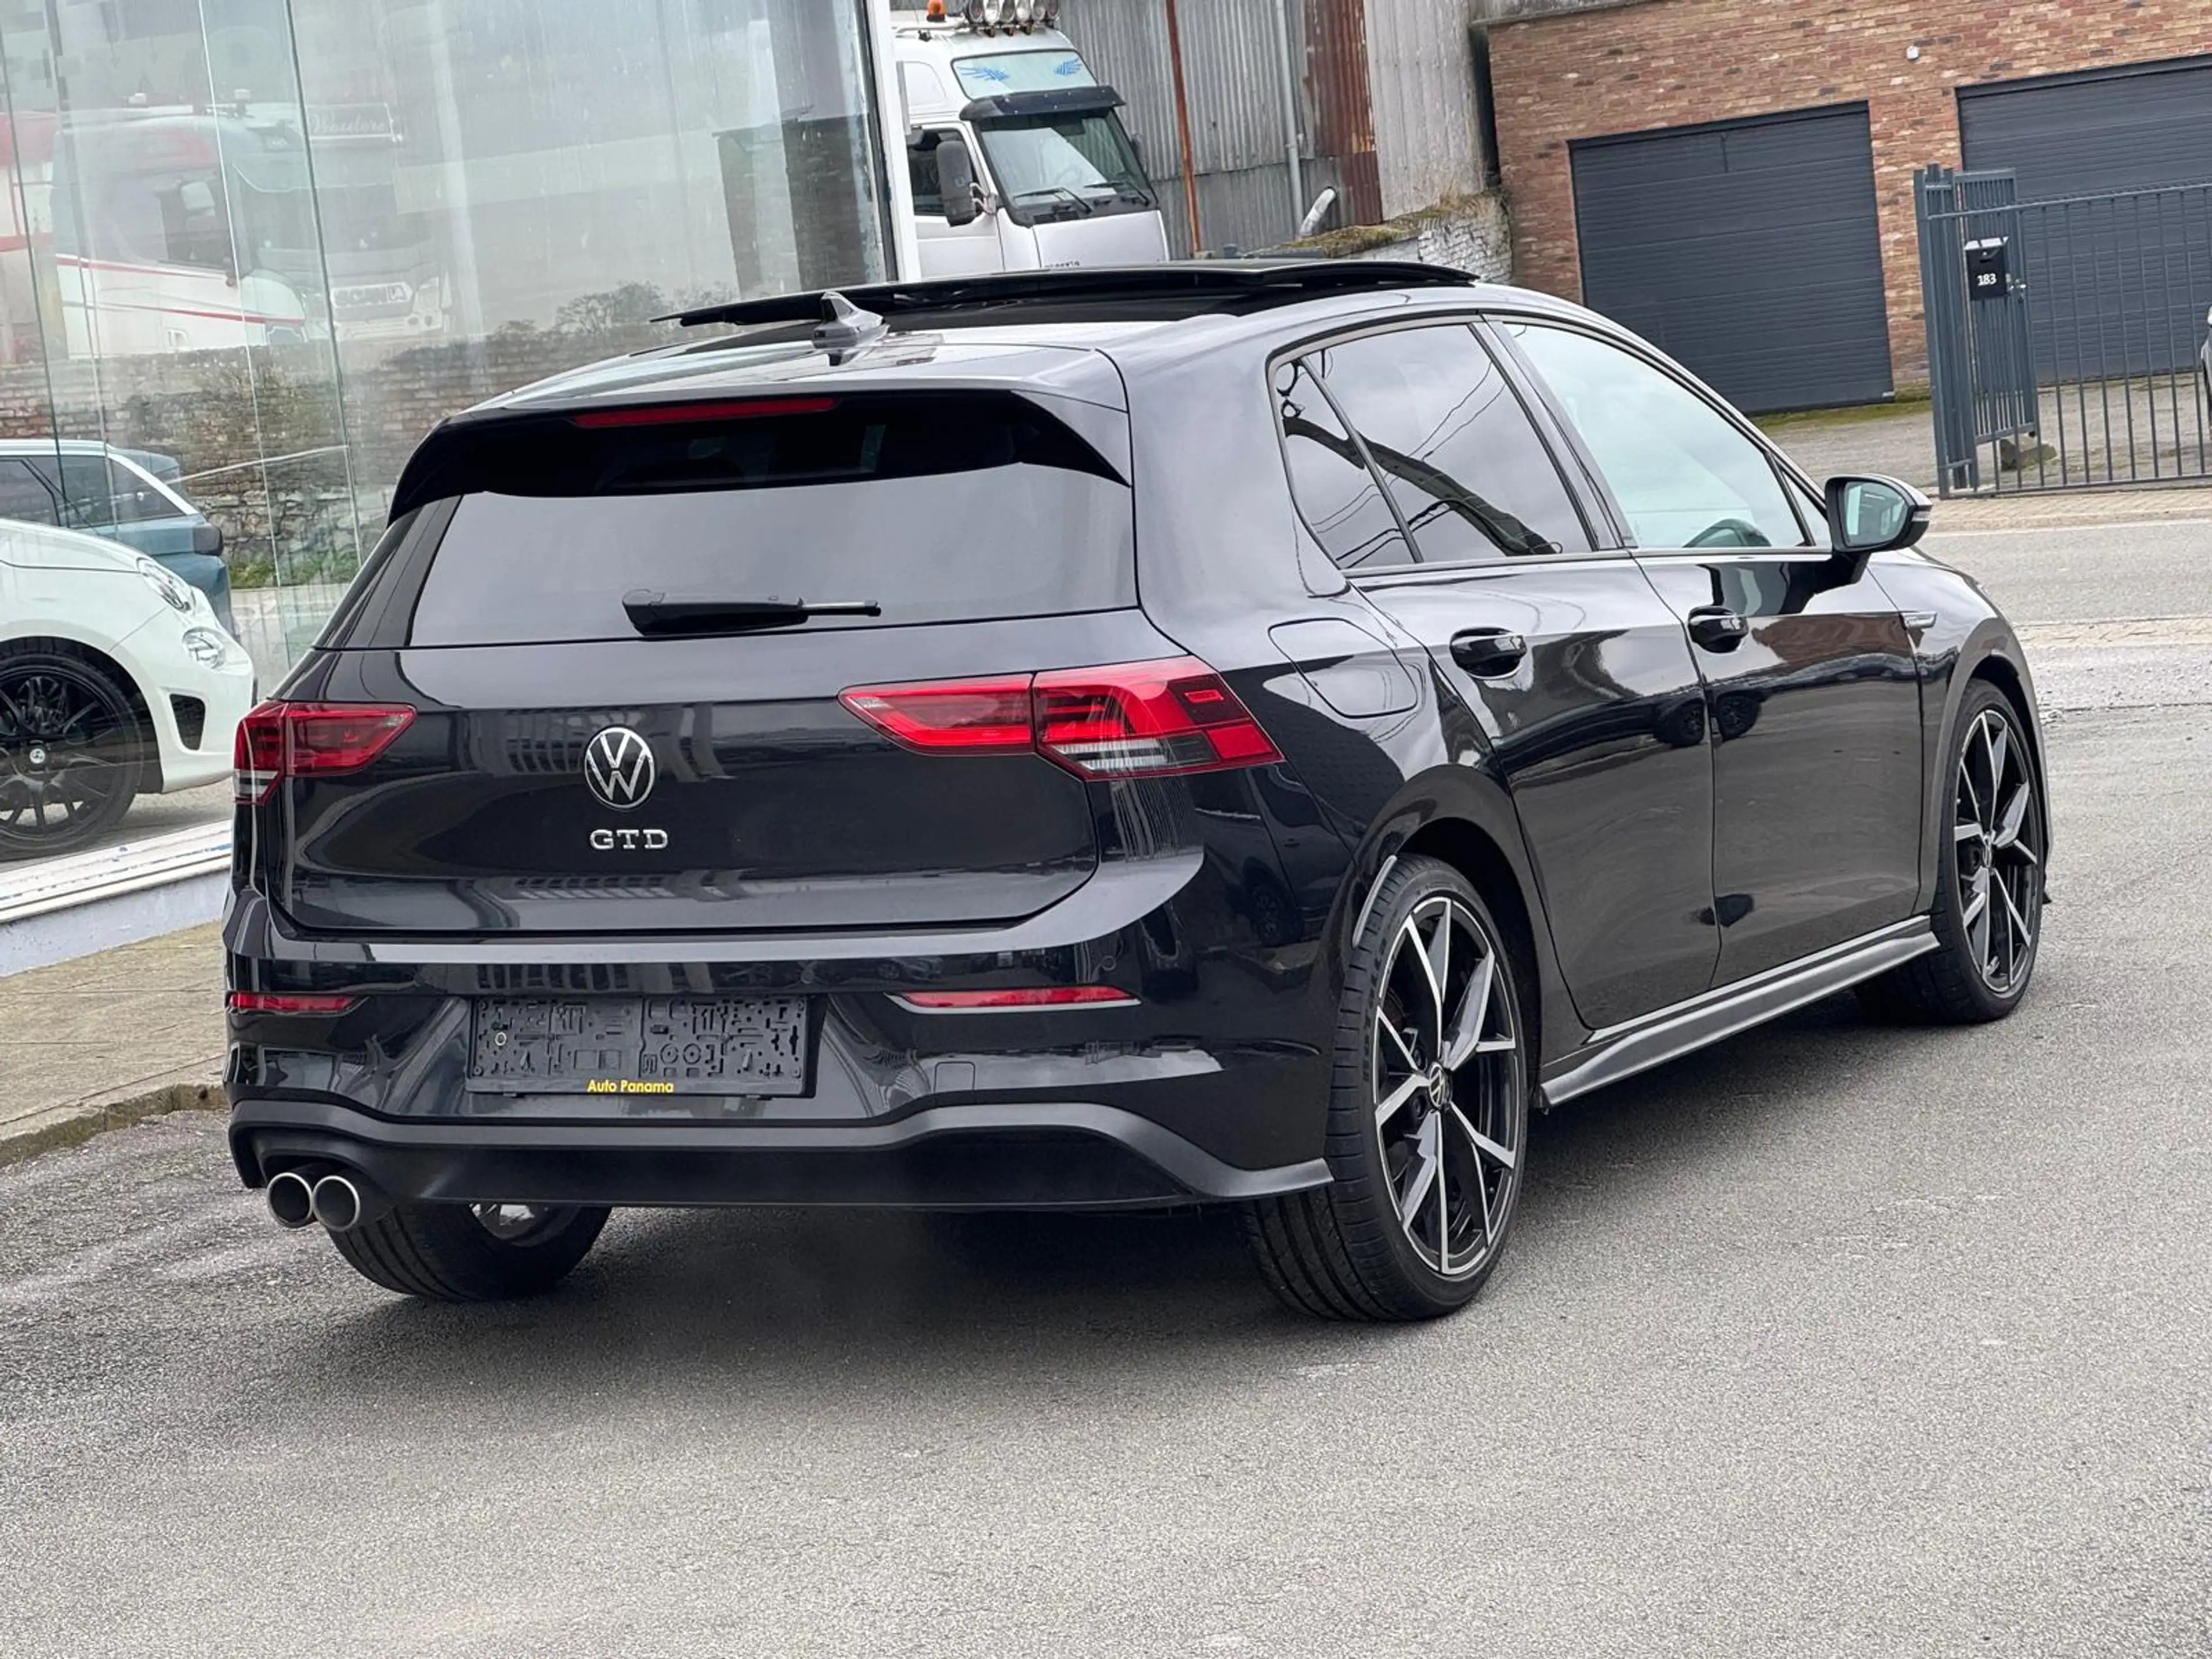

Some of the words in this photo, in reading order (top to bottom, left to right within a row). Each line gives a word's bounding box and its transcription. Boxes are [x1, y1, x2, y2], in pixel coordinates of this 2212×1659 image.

[1977, 273, 1997, 286] 183
[590, 829, 669, 850] GTD
[587, 1079, 618, 1093] Auto
[620, 1079, 674, 1093] Panama
